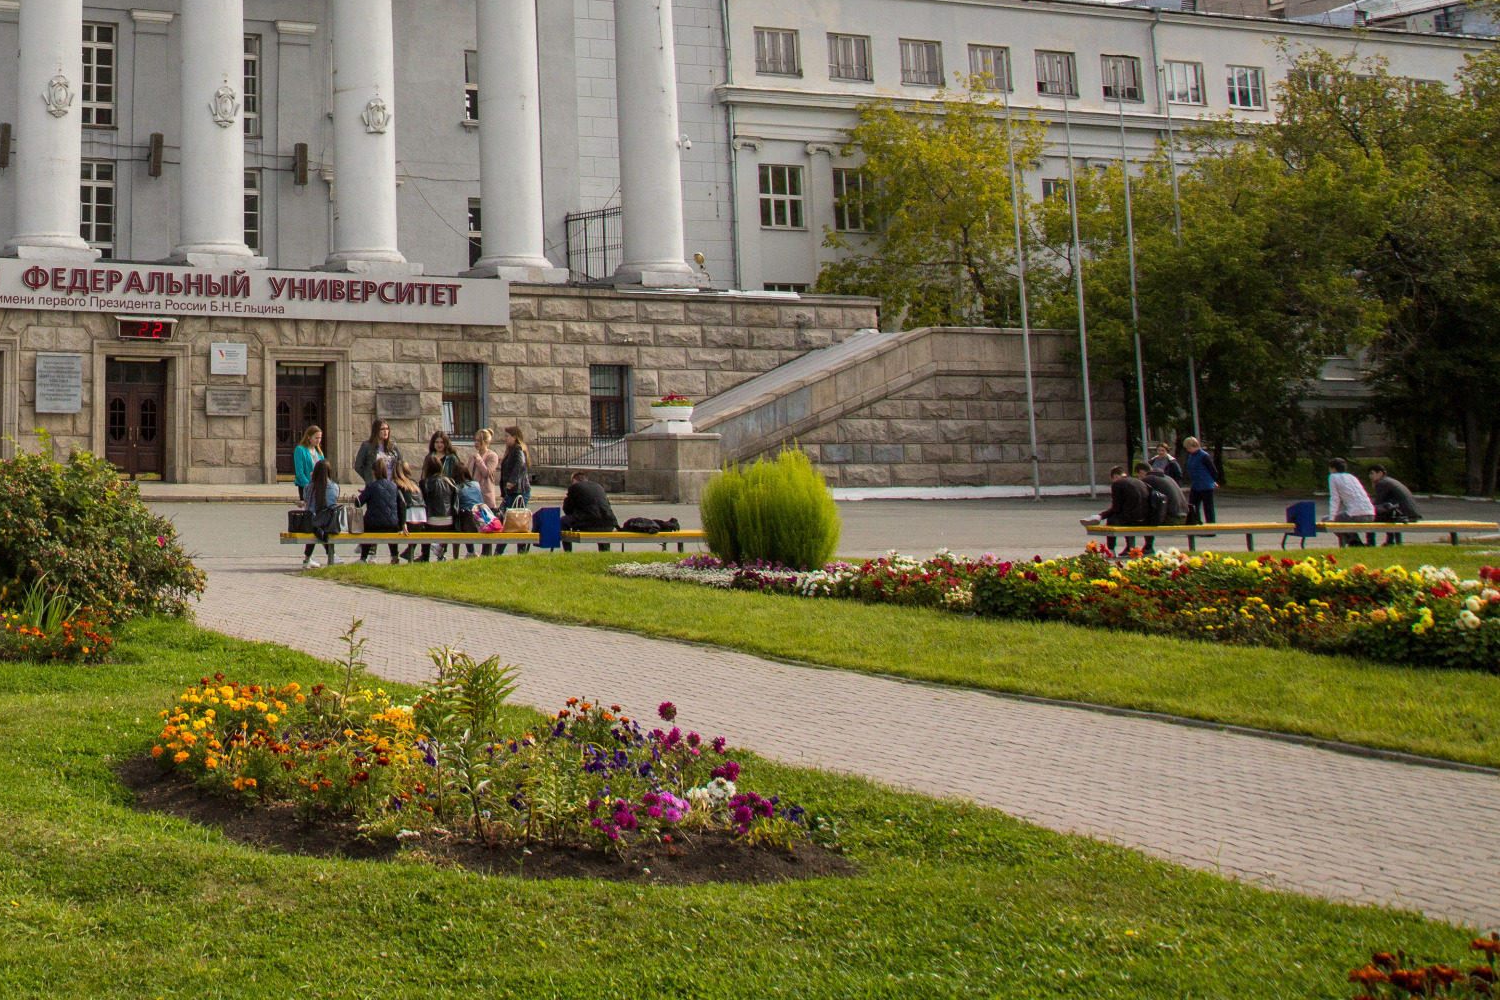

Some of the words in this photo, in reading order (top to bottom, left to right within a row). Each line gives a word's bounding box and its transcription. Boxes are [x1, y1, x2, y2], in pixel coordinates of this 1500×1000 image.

[22, 264, 251, 298] ФЕДЕРАЛЬНЫЙ
[269, 276, 462, 306] УНИВЕРСИТЕТ
[38, 296, 87, 309] первого
[89, 296, 161, 310] Президента
[164, 299, 207, 311] России
